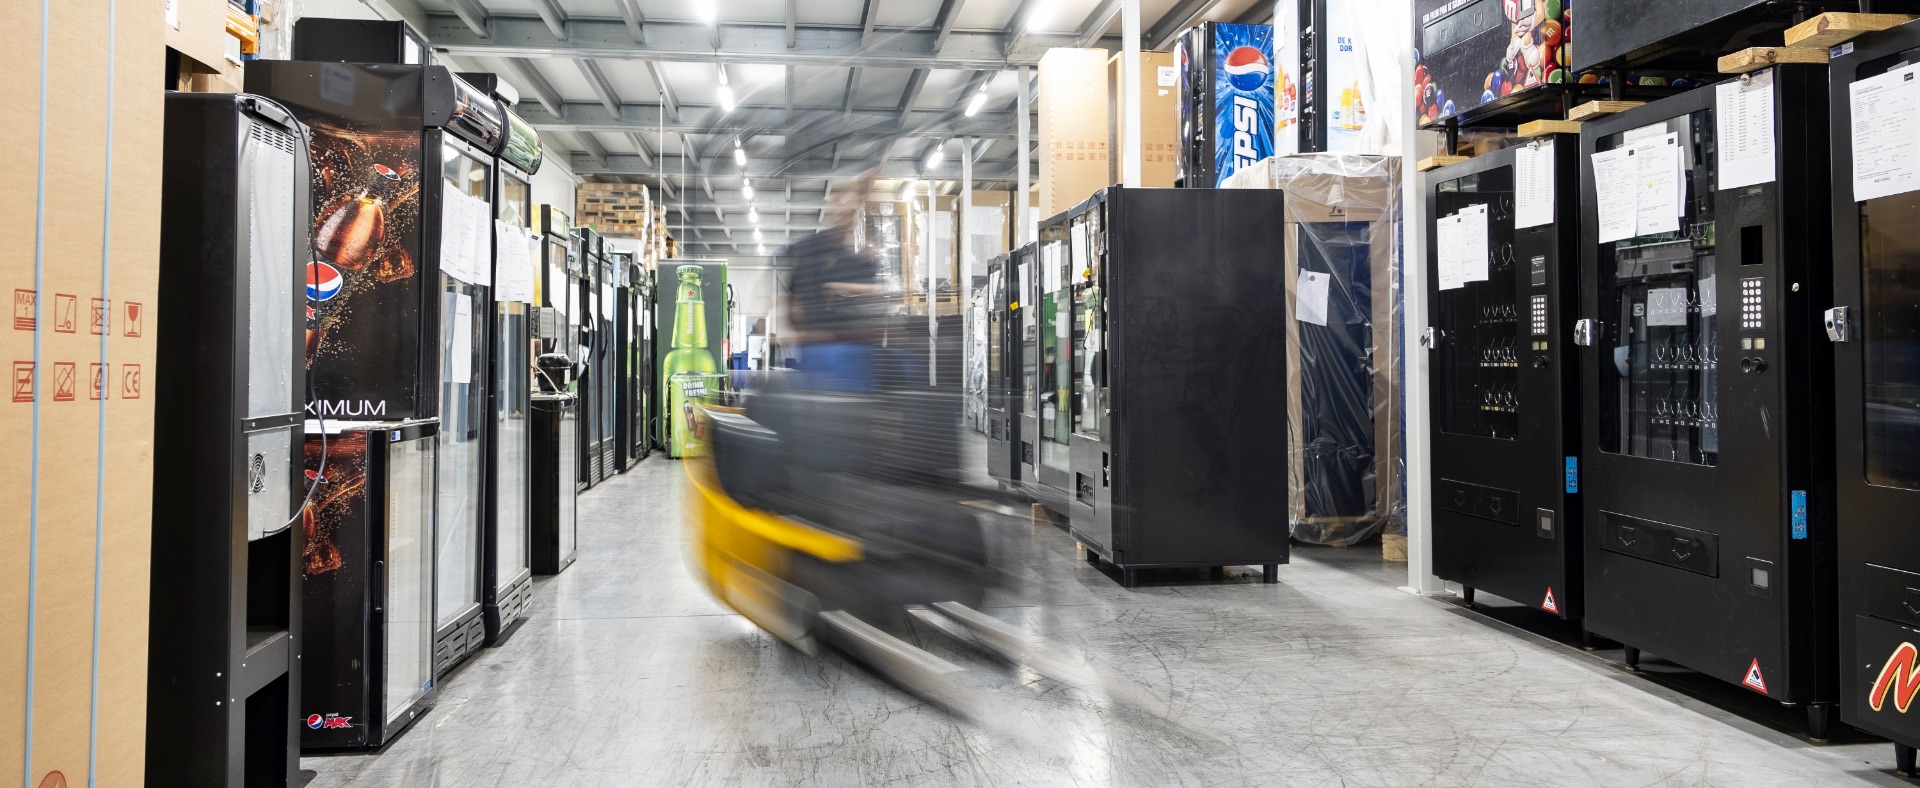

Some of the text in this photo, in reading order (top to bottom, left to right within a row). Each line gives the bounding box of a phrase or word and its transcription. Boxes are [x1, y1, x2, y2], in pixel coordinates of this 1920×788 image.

[17, 293, 36, 306] MAX
[682, 381, 704, 389] DRINK
[685, 388, 707, 397] FRESH!
[323, 717, 353, 729] MAX
